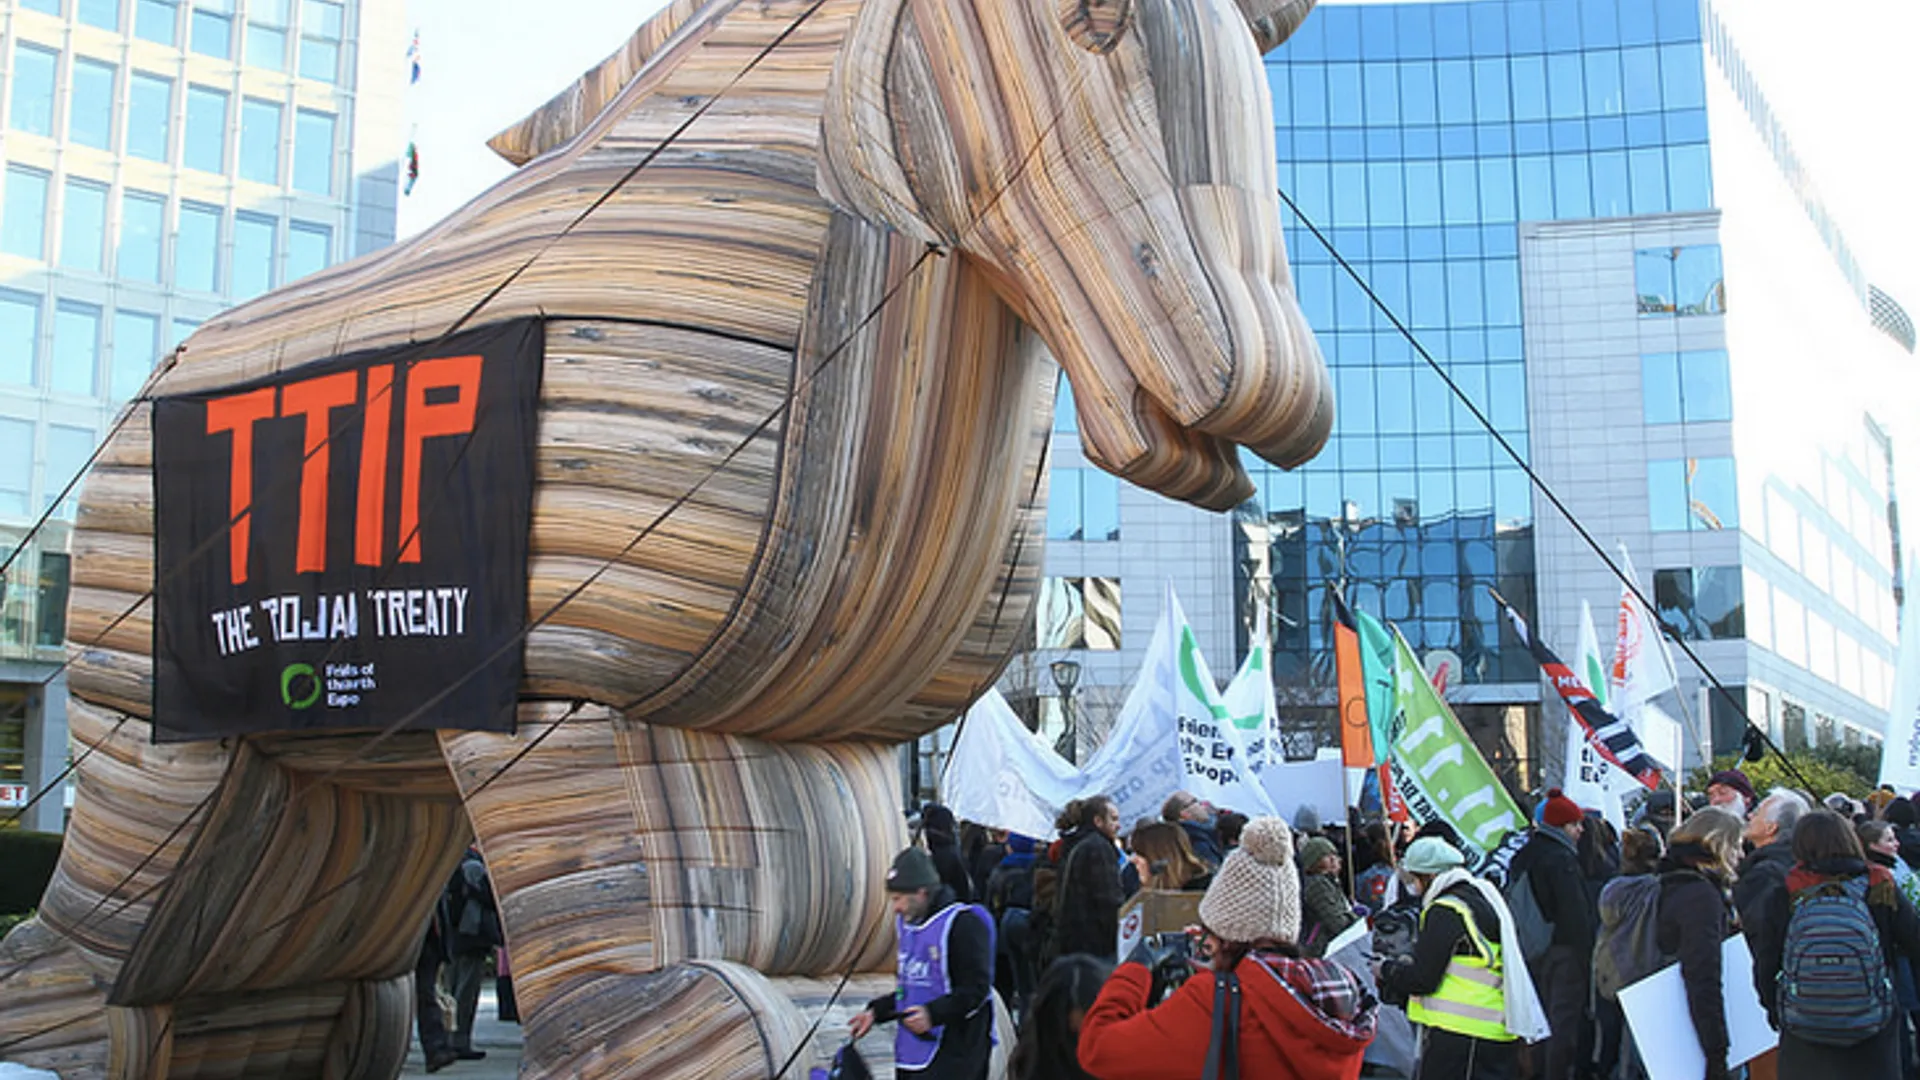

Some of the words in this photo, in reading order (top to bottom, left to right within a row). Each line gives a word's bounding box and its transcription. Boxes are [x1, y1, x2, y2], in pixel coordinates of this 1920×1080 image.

[206, 355, 484, 585] TTIP
[212, 605, 260, 656] THE
[367, 587, 469, 637] TREATY
